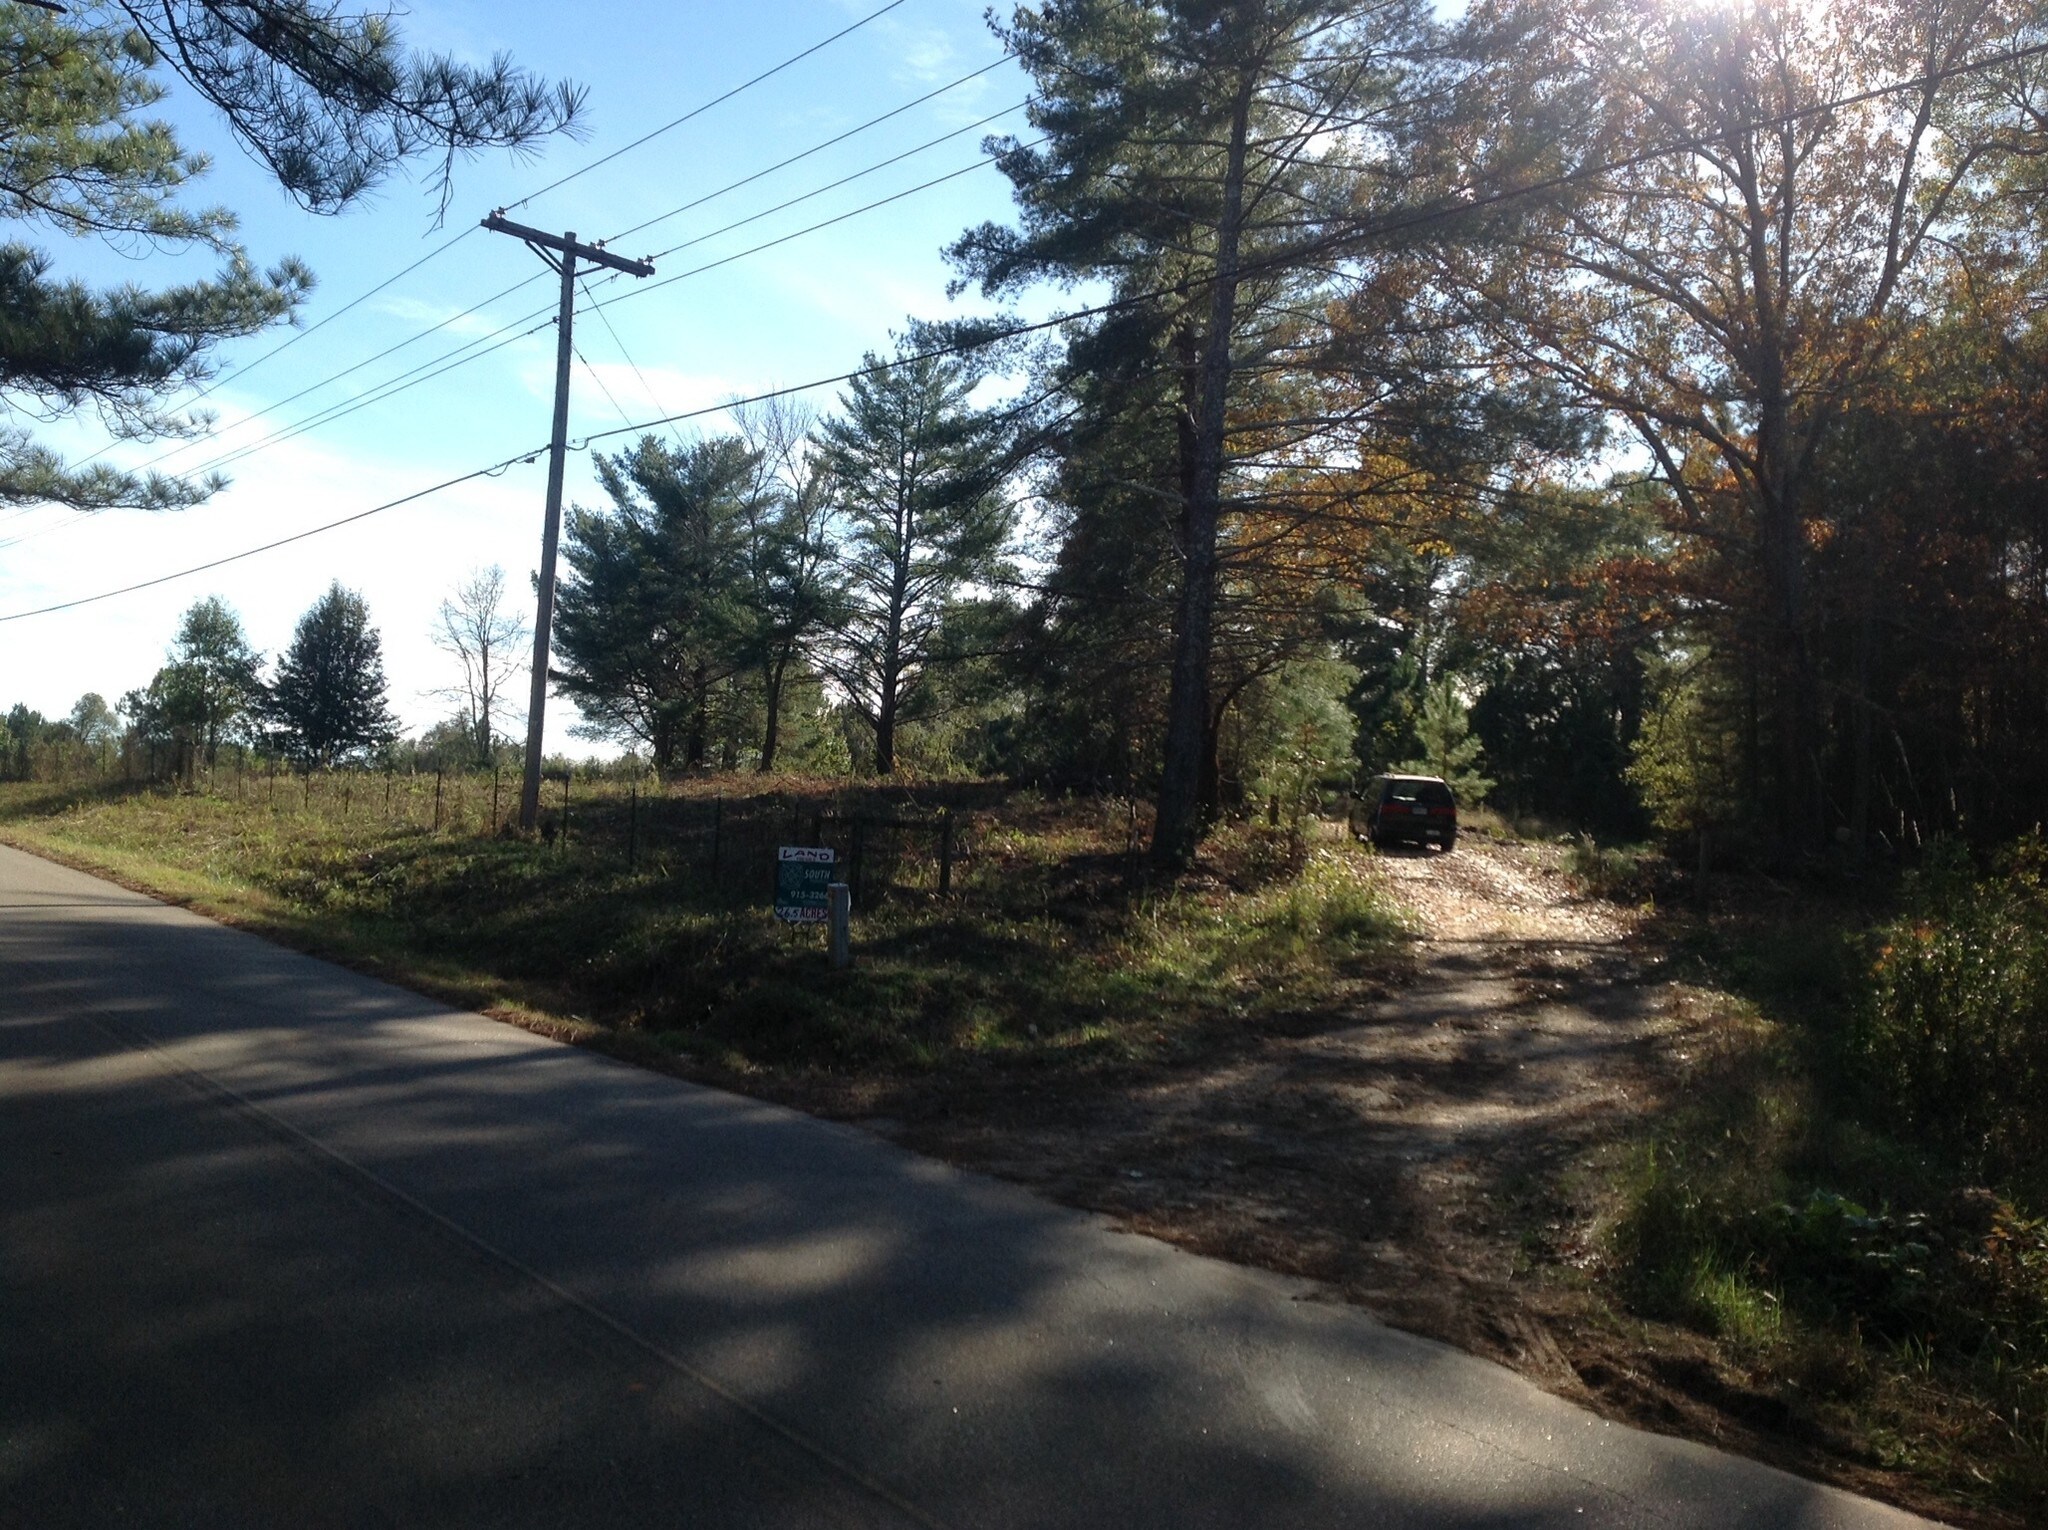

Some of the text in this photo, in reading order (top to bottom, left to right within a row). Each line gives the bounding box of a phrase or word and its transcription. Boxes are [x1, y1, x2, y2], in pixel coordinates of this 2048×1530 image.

[783, 850, 830, 861] LAND
[804, 868, 831, 880] SOUTH
[800, 906, 829, 919] ACRES
